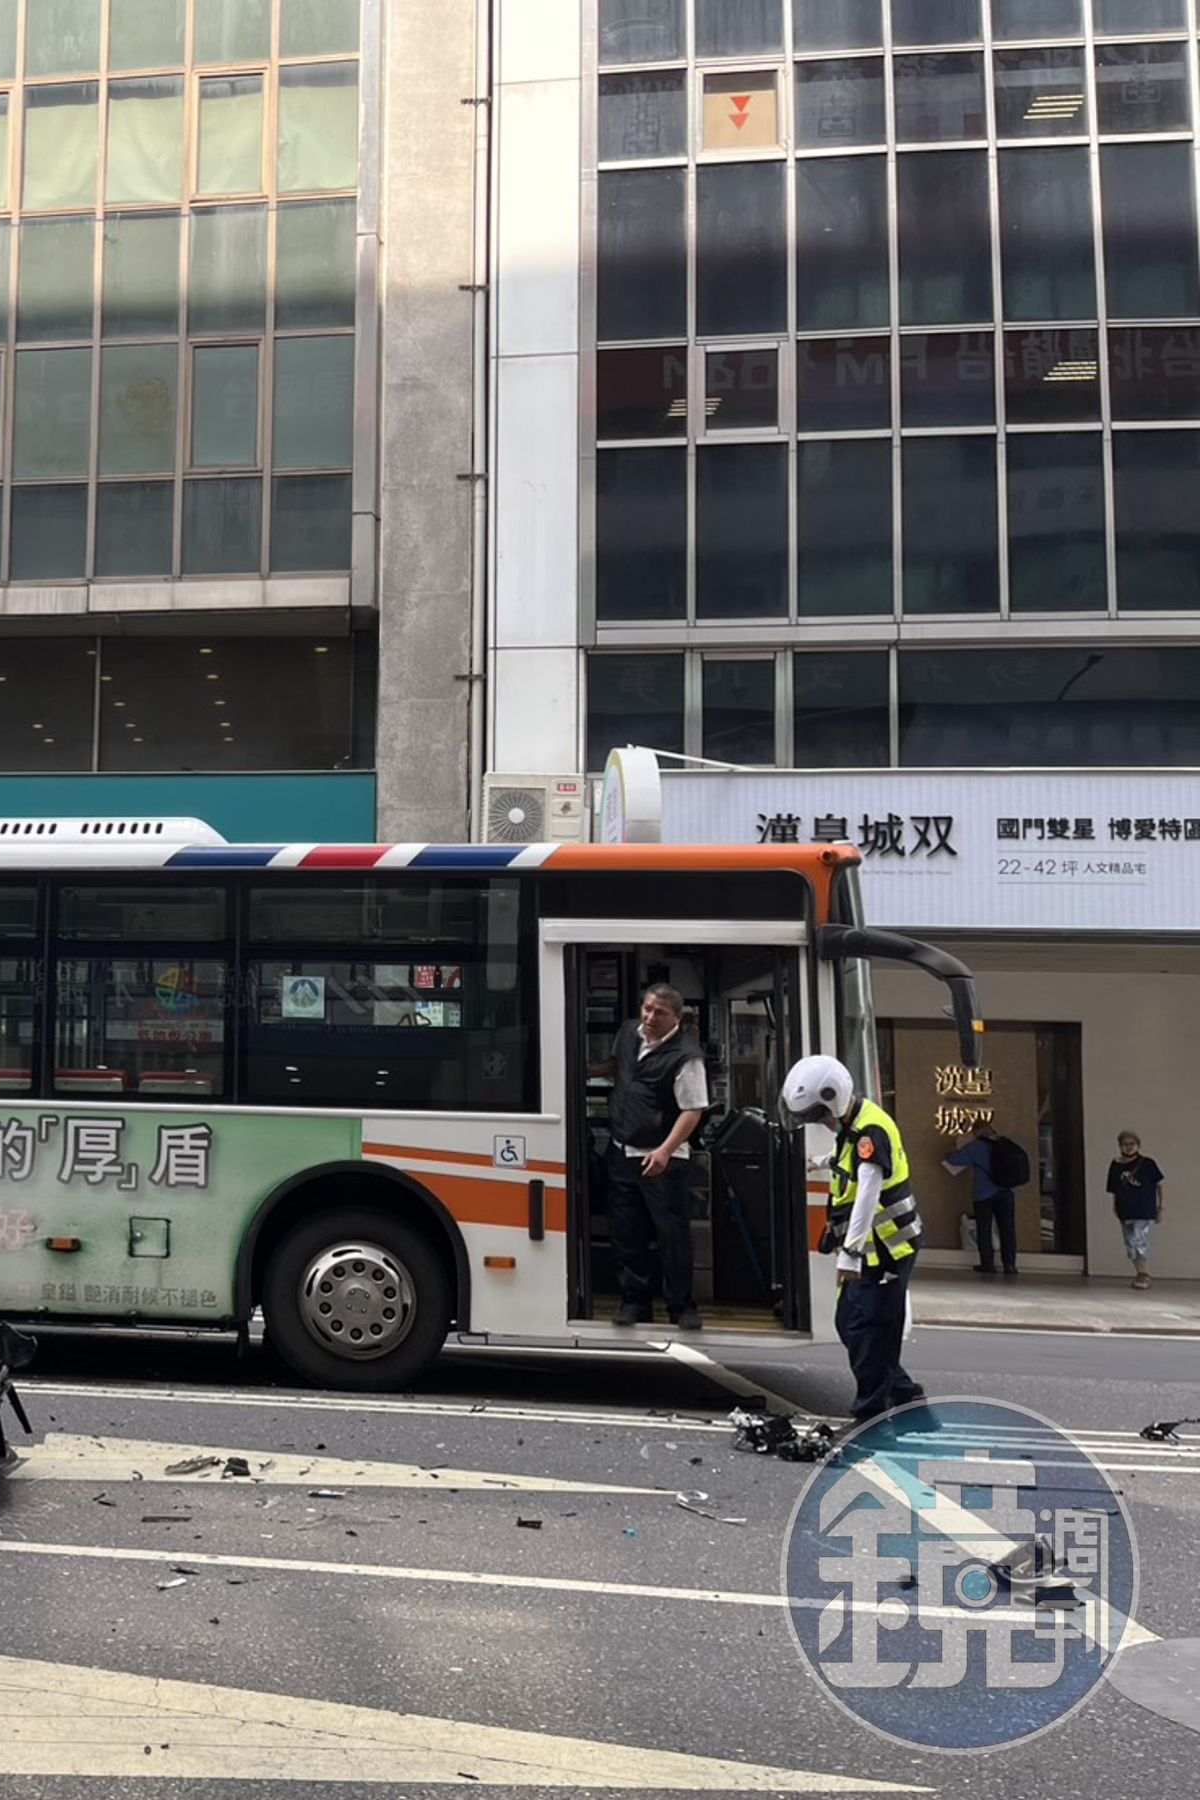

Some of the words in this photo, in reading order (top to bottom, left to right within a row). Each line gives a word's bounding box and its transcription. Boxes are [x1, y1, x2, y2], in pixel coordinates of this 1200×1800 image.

[996, 816, 1096, 842] 國門雙星
[1061, 859, 1080, 877] 坪
[1082, 861, 1147, 876] 人文精品宅
